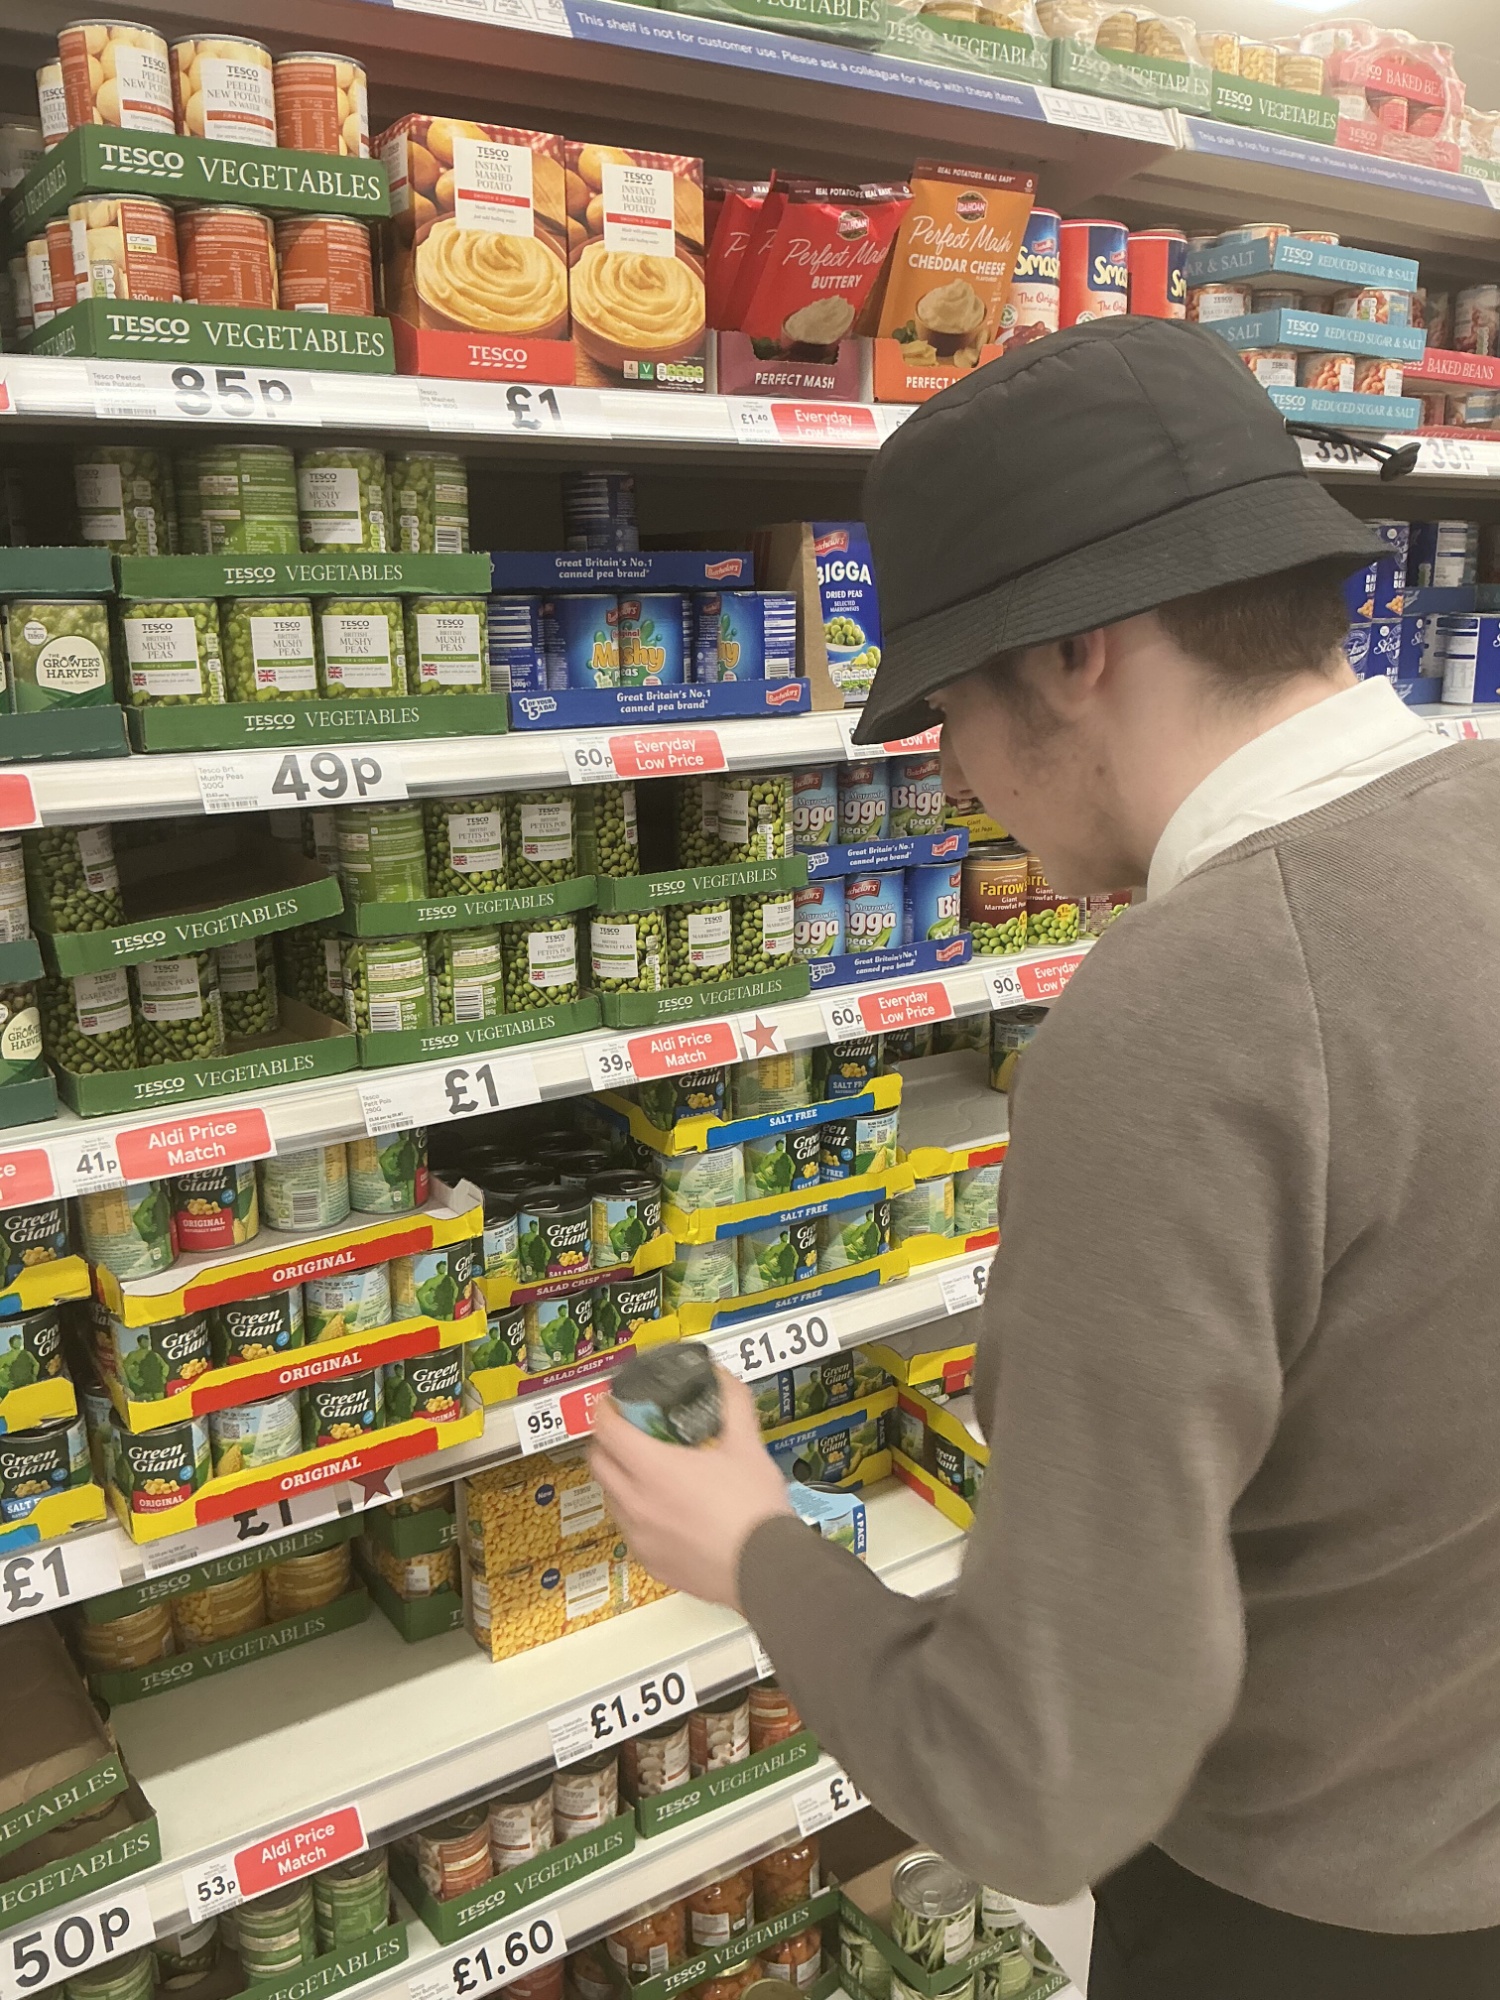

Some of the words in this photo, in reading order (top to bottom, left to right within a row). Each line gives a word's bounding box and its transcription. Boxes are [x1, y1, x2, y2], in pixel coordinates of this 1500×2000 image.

[576, 12, 604, 27] This
[607, 18, 637, 33] shelf
[640, 22, 650, 36] is
[653, 26, 674, 40] not
[677, 30, 694, 43] for
[698, 36, 753, 54] customer
[756, 47, 780, 60] use.
[782, 50, 818, 67] Please
[820, 59, 839, 71] ask
[841, 63, 848, 72] a
[850, 63, 900, 83] colleague
[901, 73, 916, 85] for
[918, 77, 941, 92] help
[943, 81, 964, 94] with
[966, 87, 993, 100] these
[995, 92, 1023, 105] items.
[1217, 87, 1253, 106] TESCO
[1258, 97, 1337, 131] VEGETABLES
[476, 146, 509, 158] TESCO
[99, 143, 184, 170] TESCO
[198, 156, 382, 200] VEGETABLES
[474, 160, 512, 173] INSTANT
[475, 170, 513, 182] MASHED
[476, 179, 512, 192] POTATO
[956, 201, 986, 213] IDAHOAN
[908, 215, 970, 252] Perfect
[973, 224, 1013, 253] Mash
[783, 238, 848, 276] Perfect
[908, 253, 967, 273] CHEDDAR
[969, 259, 1006, 276] CHEESE
[1282, 246, 1313, 260] TESCO
[1317, 254, 1357, 271] REDUCED
[1358, 263, 1386, 278] SUGAR
[1395, 268, 1415, 282] SALT
[811, 274, 863, 289] BUTTERY
[106, 314, 190, 336] TESCO
[202, 321, 385, 357] VEGETABLES
[1286, 319, 1319, 333] TESCO
[1325, 327, 1365, 343] REDUCED
[1365, 332, 1393, 347] SUGAR
[1402, 336, 1423, 350] SALT
[468, 345, 528, 363] TESCO
[1427, 358, 1461, 376] BAKED
[1462, 364, 1494, 380] BEANS
[755, 372, 801, 387] PERFECT
[803, 374, 835, 389] MASH
[905, 376, 948, 389] PERFECT
[171, 367, 293, 418] 85p
[506, 386, 565, 431] £1
[794, 409, 852, 427] Everyday
[223, 567, 276, 580] TESCO
[285, 565, 403, 582] VEGETABLES
[848, 590, 862, 598] PEAS
[141, 622, 173, 631] TESCO
[142, 641, 177, 652] MUSHY
[147, 650, 173, 659] PEAS
[46, 668, 99, 678] HARVEST
[617, 692, 644, 702] Great
[646, 691, 687, 700] Britain's
[689, 689, 711, 698] No.1
[620, 702, 655, 713] canned
[657, 702, 675, 712] pea
[634, 738, 696, 756] Everyday
[574, 748, 613, 767] 60p
[635, 757, 665, 771] Low
[668, 753, 704, 768] Price
[200, 774, 225, 782] Mushy
[271, 752, 382, 801] 49p
[649, 880, 686, 893] TESCO
[692, 868, 777, 890] VEGETABLES
[417, 905, 457, 918] TESCO
[464, 893, 555, 916] VEGETABLES
[985, 901, 1017, 911] Marrowfat
[111, 931, 166, 950] TESCO
[174, 899, 298, 941] VEGETABLES
[993, 978, 1022, 994] 90p
[878, 991, 928, 1009] Everyday
[831, 1007, 862, 1027] 60p
[880, 1011, 905, 1025] Low
[906, 1004, 936, 1018] Price
[651, 1040, 676, 1053] Aldi
[679, 1033, 712, 1047] Price
[599, 1054, 632, 1073] 39p
[665, 1050, 706, 1067] Match
[444, 1063, 500, 1115] £1
[770, 1114, 793, 1127] SALT
[795, 1109, 818, 1122] FREE
[148, 1127, 183, 1149] Aldi
[189, 1121, 237, 1141] Price
[76, 1151, 117, 1175] 41p
[167, 1142, 226, 1166] Match
[177, 1176, 229, 1191] Giant
[4, 1208, 59, 1231] Green
[182, 1218, 225, 1227] ORIGINAL
[780, 1211, 805, 1222] SALT
[806, 1204, 828, 1216] FREE
[9, 1217, 62, 1244] Giant
[547, 1220, 587, 1236] Green
[551, 1230, 589, 1247] Giant
[272, 1251, 356, 1283] ORIGINAL
[536, 1281, 570, 1296] SALAD
[571, 1275, 601, 1289] CRISP
[226, 1308, 281, 1325] Green
[231, 1319, 285, 1338] Giant
[739, 1316, 829, 1372] £1.30
[279, 1352, 362, 1384] ORIGINAL
[316, 1388, 368, 1407] Green
[320, 1399, 370, 1418] Giant
[527, 1410, 563, 1433] 95p
[280, 1456, 361, 1491] ORIGINAL
[537, 1490, 554, 1499] New
[856, 1521, 865, 1548] PACK
[137, 1574, 192, 1599] TESCO
[200, 1529, 324, 1580] VEGETABLES
[2, 1546, 70, 1613] £1
[590, 1671, 686, 1738] £1.50
[656, 1791, 701, 1816] TESCO
[708, 1743, 807, 1797] VEGETABLES
[261, 1838, 292, 1864] Aldi
[294, 1822, 335, 1848] Price
[278, 1848, 327, 1876] Match
[457, 1890, 506, 1919] TESCO
[514, 1831, 624, 1895] VEGETABLES
[197, 1875, 237, 1902] 53p
[12, 1905, 131, 1989] 50p
[452, 1920, 554, 1995] £1.60
